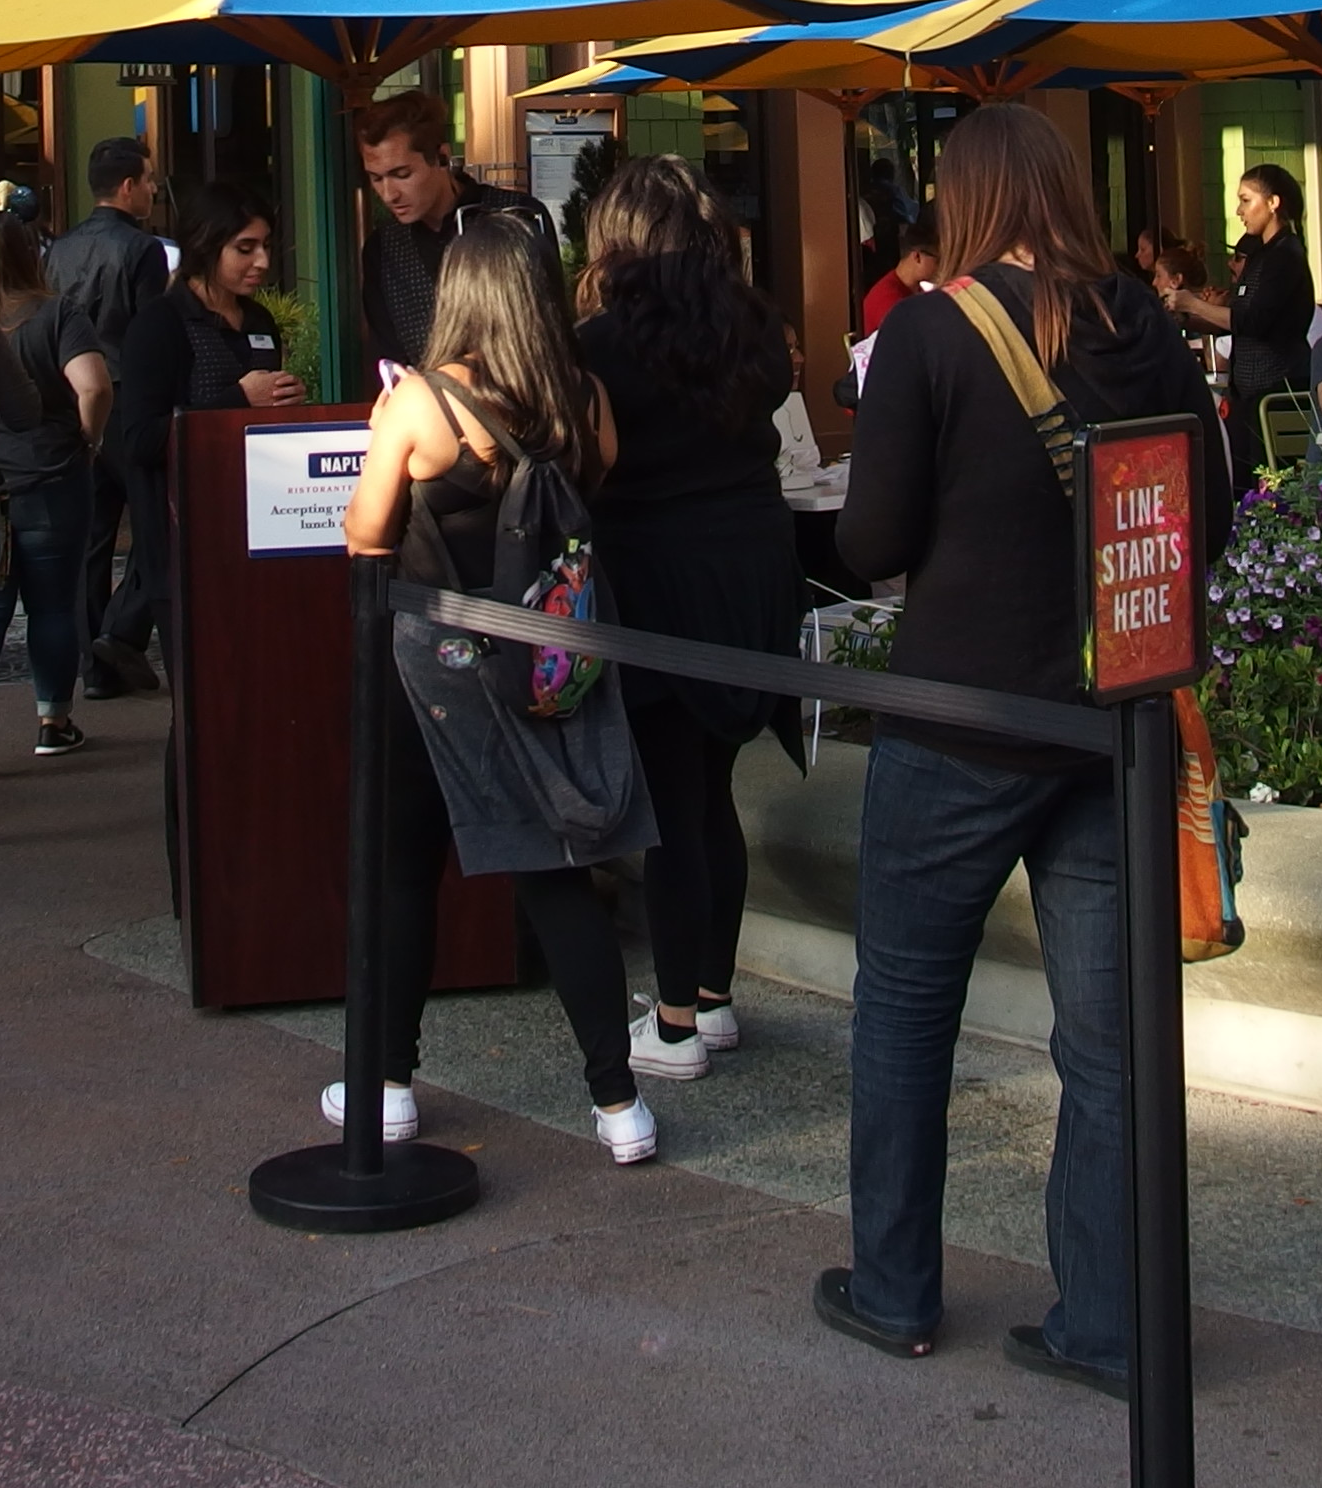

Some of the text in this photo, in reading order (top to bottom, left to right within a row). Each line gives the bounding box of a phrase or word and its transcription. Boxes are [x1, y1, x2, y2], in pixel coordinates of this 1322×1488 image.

[320, 455, 368, 474] NAPLE
[287, 485, 353, 494] RISTORANTE
[270, 504, 333, 516] Accepting
[1116, 484, 1165, 531] LINE
[300, 518, 335, 530] lunch
[1102, 531, 1182, 585] STARTS
[1114, 584, 1171, 633] HERE
